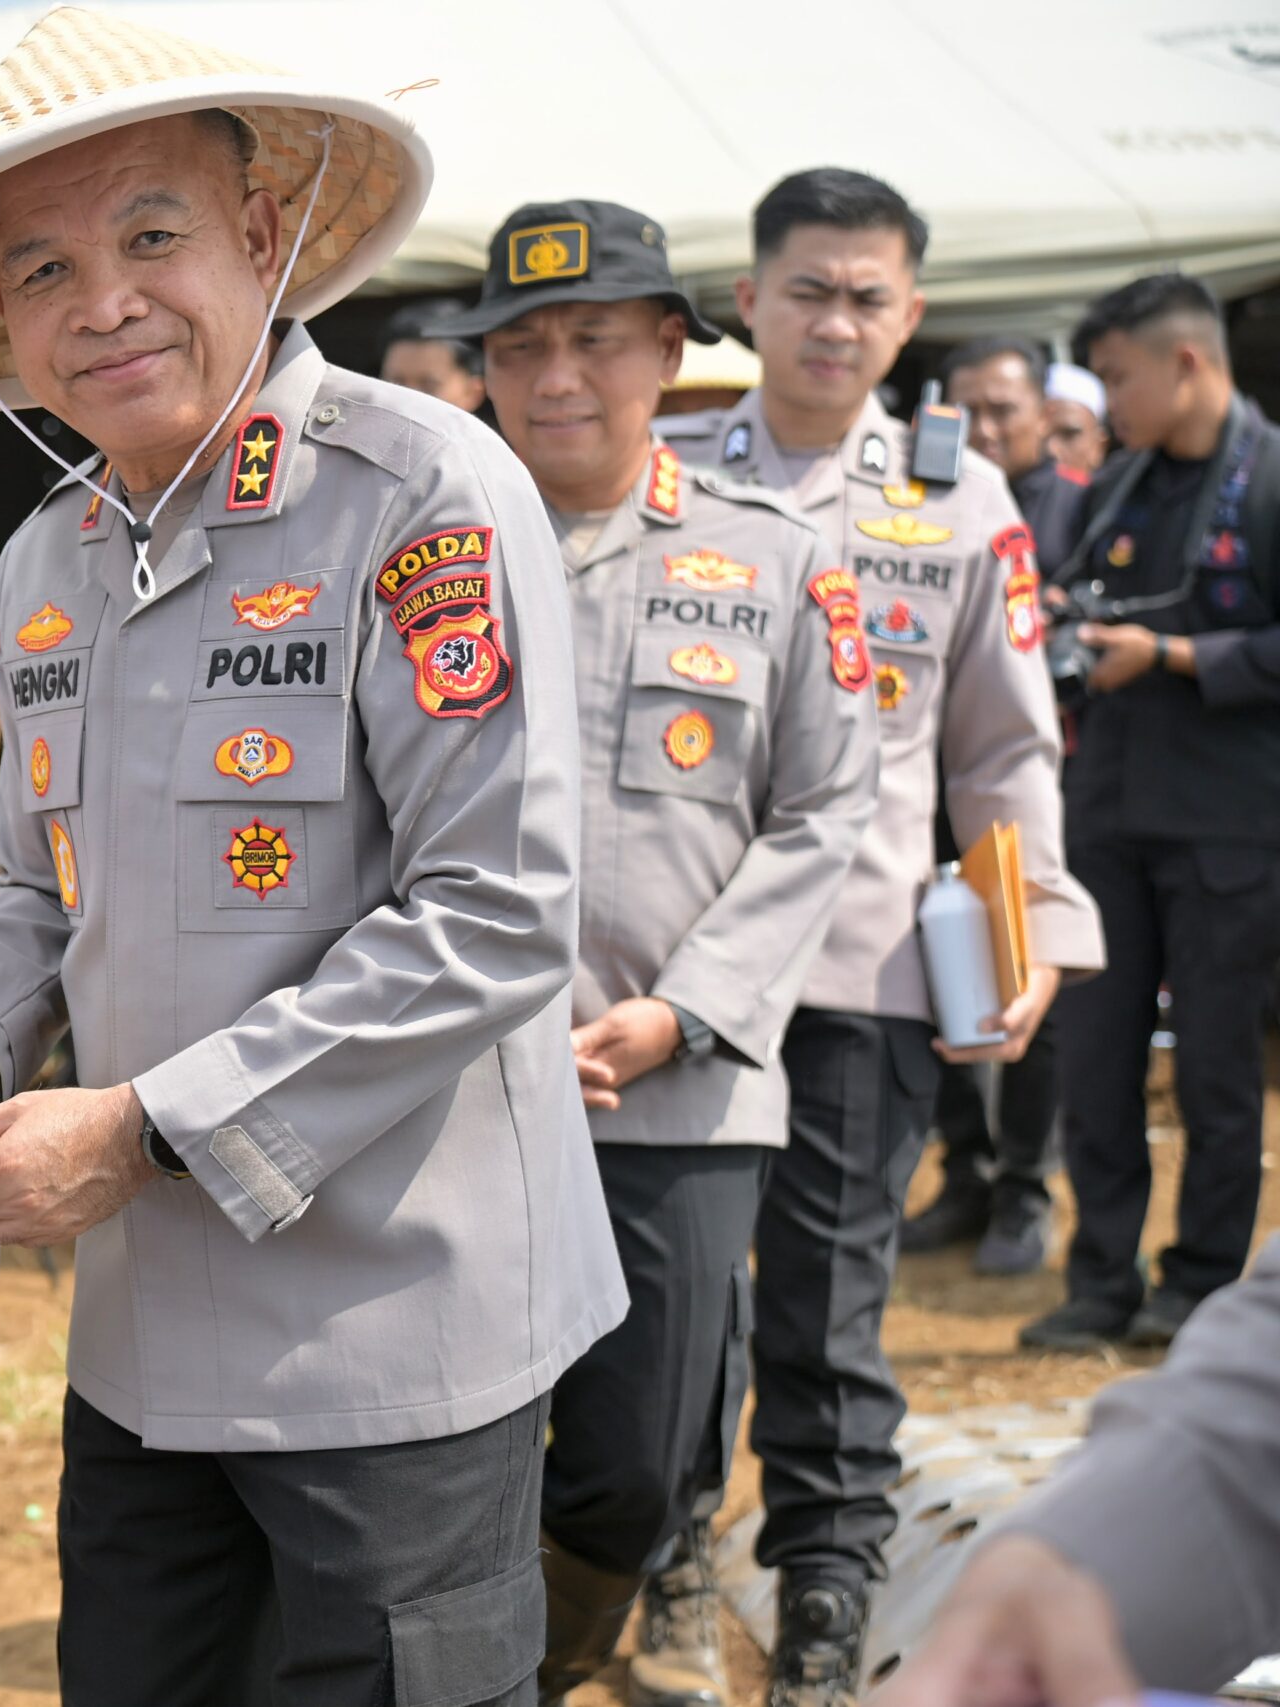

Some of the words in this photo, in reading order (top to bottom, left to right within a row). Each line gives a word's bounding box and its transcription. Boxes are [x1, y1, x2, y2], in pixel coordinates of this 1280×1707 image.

[380, 533, 483, 593] POLDA
[853, 556, 953, 591] POLRI
[398, 590, 433, 623] JAWA
[433, 579, 484, 602] BARAT
[646, 597, 768, 638] POLRI
[10, 658, 80, 710] HENGKI
[206, 641, 327, 689] POLRI
[244, 736, 264, 746] SAR
[245, 851, 276, 865] BRIMOB
